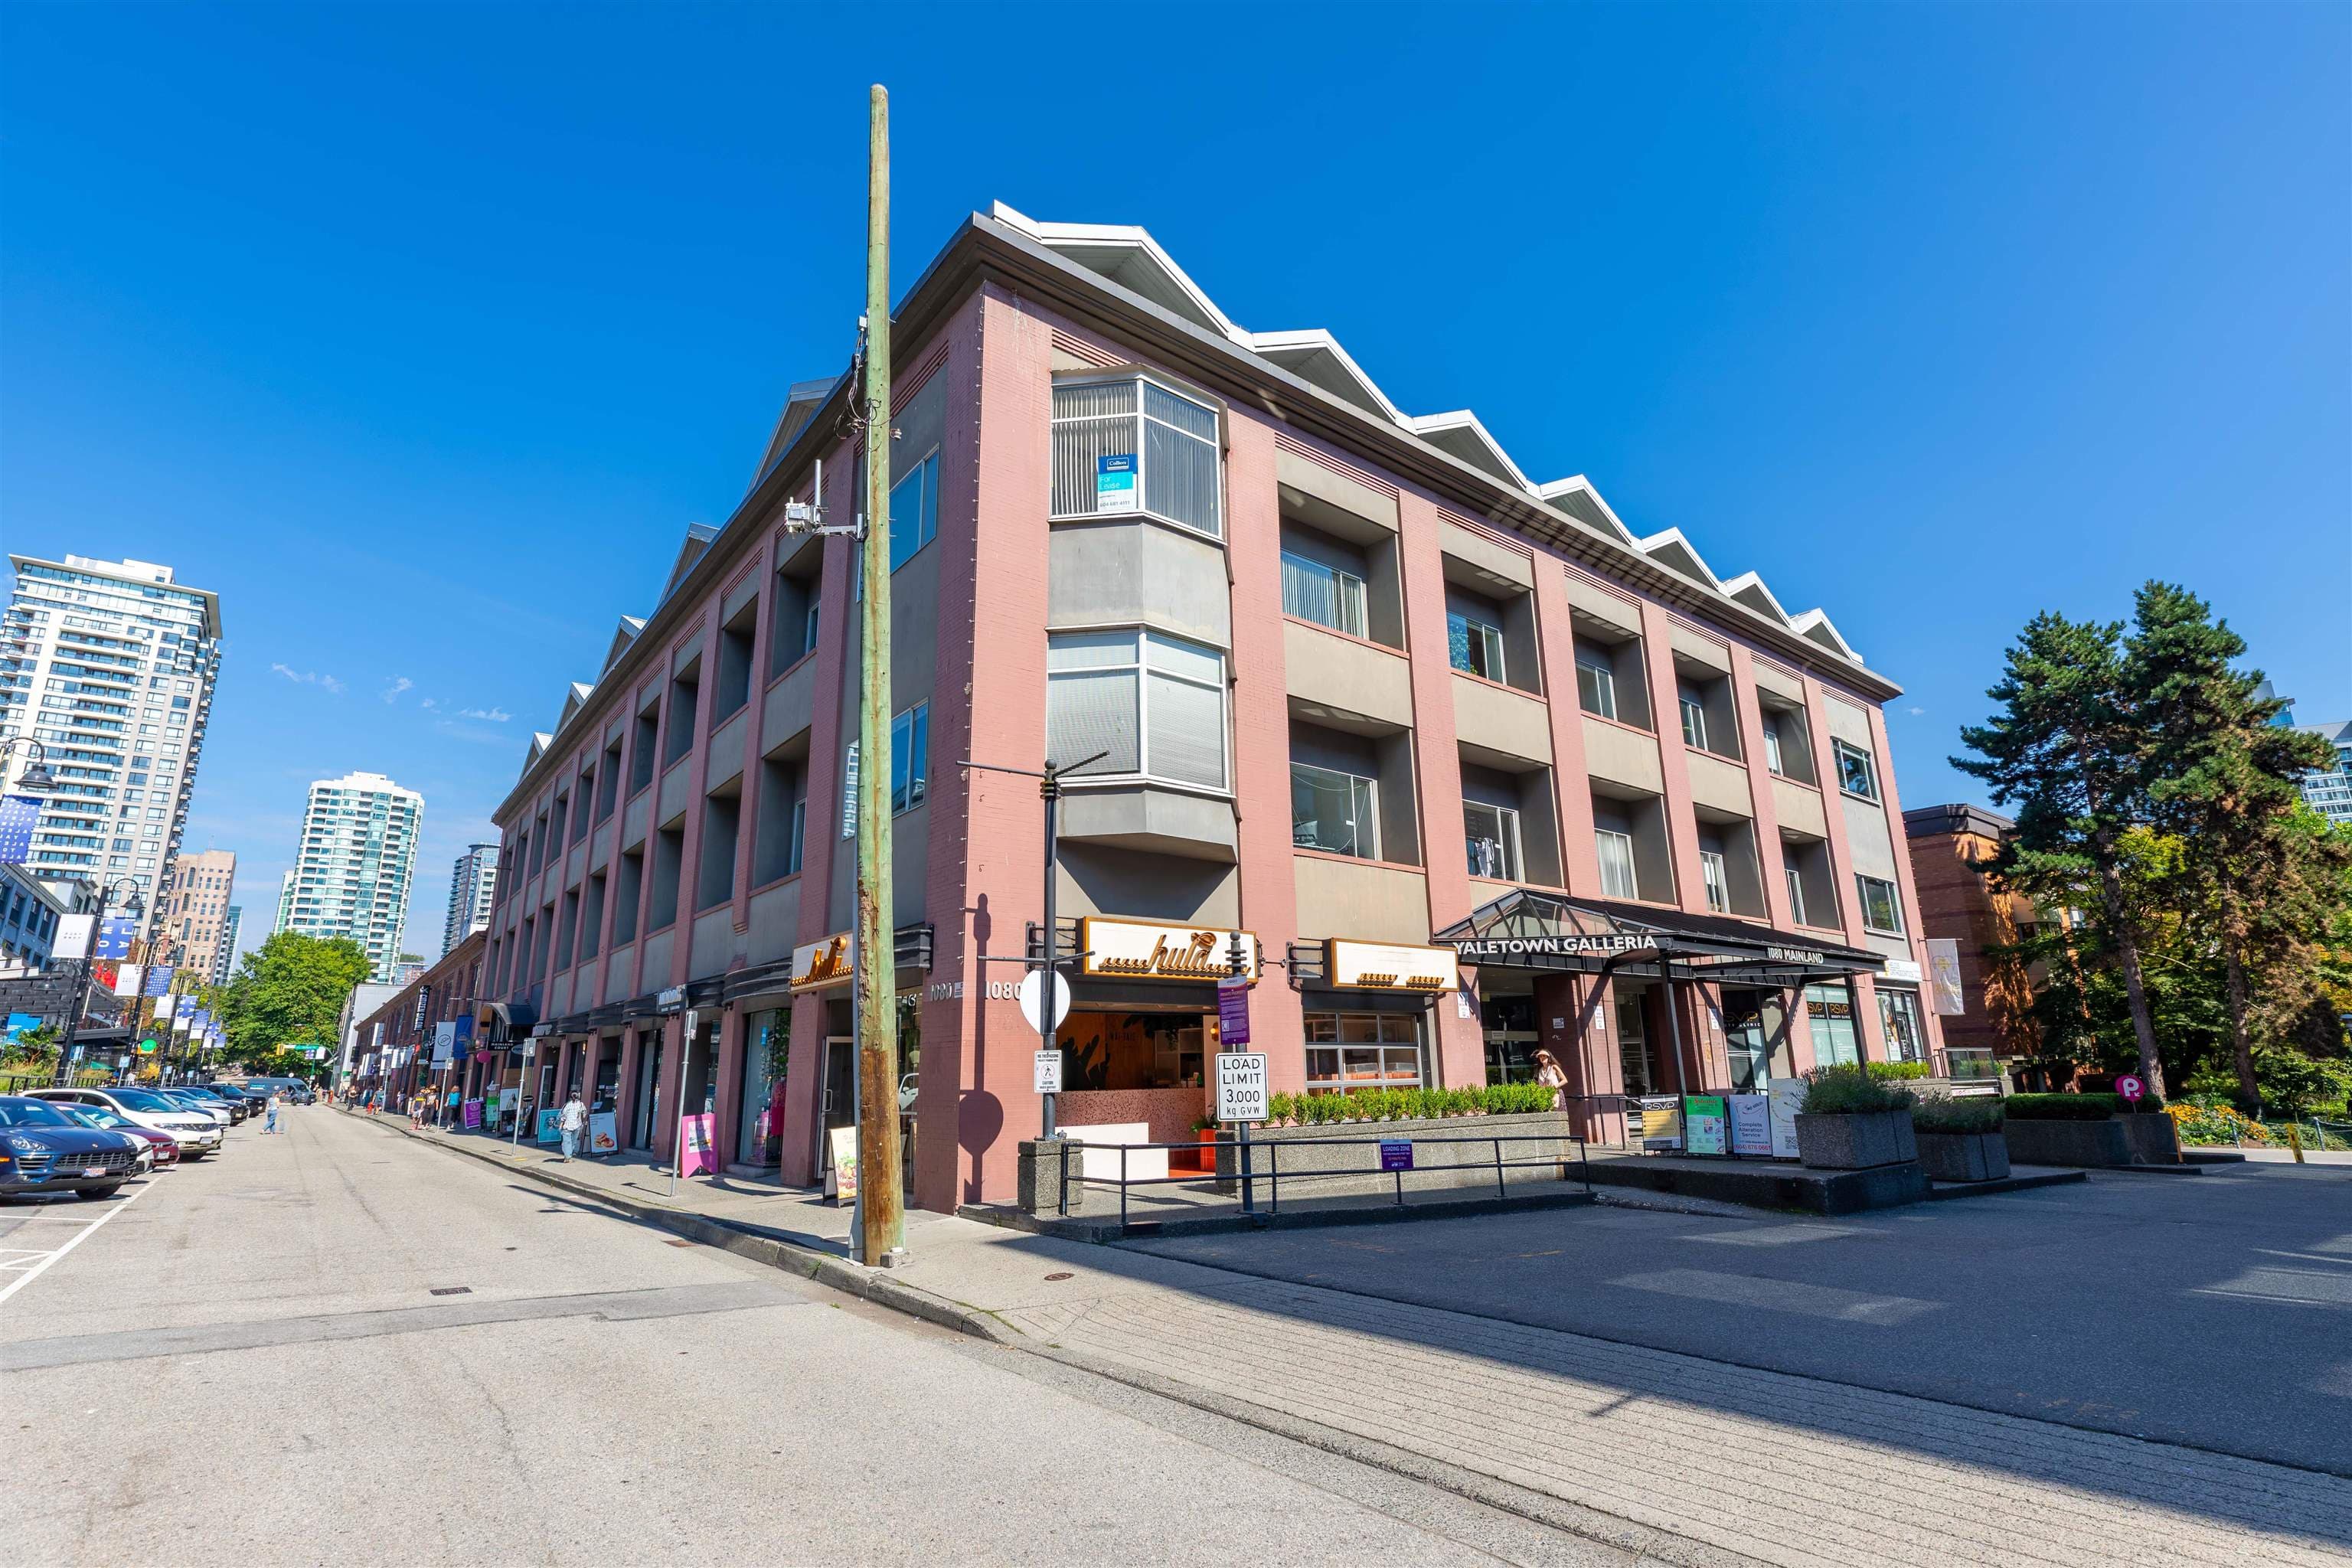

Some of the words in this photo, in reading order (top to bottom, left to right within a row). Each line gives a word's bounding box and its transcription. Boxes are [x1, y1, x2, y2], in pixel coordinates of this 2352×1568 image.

[1453, 939, 1558, 955] YALETOWN
[1563, 936, 1658, 951] GALLERIA
[1768, 947, 1782, 959] 1080
[1784, 949, 1824, 964] MAINLAND
[1830, 1004, 1849, 1014] RSVP
[1223, 1059, 1260, 1070] LOAD
[1223, 1073, 1261, 1085] LIMIT
[2123, 1078, 2139, 1096] P
[1227, 1089, 1259, 1103] 3,000
[1227, 1106, 1236, 1117] kg
[1240, 1106, 1259, 1115] GVW
[1645, 1102, 1674, 1110] RSVP
